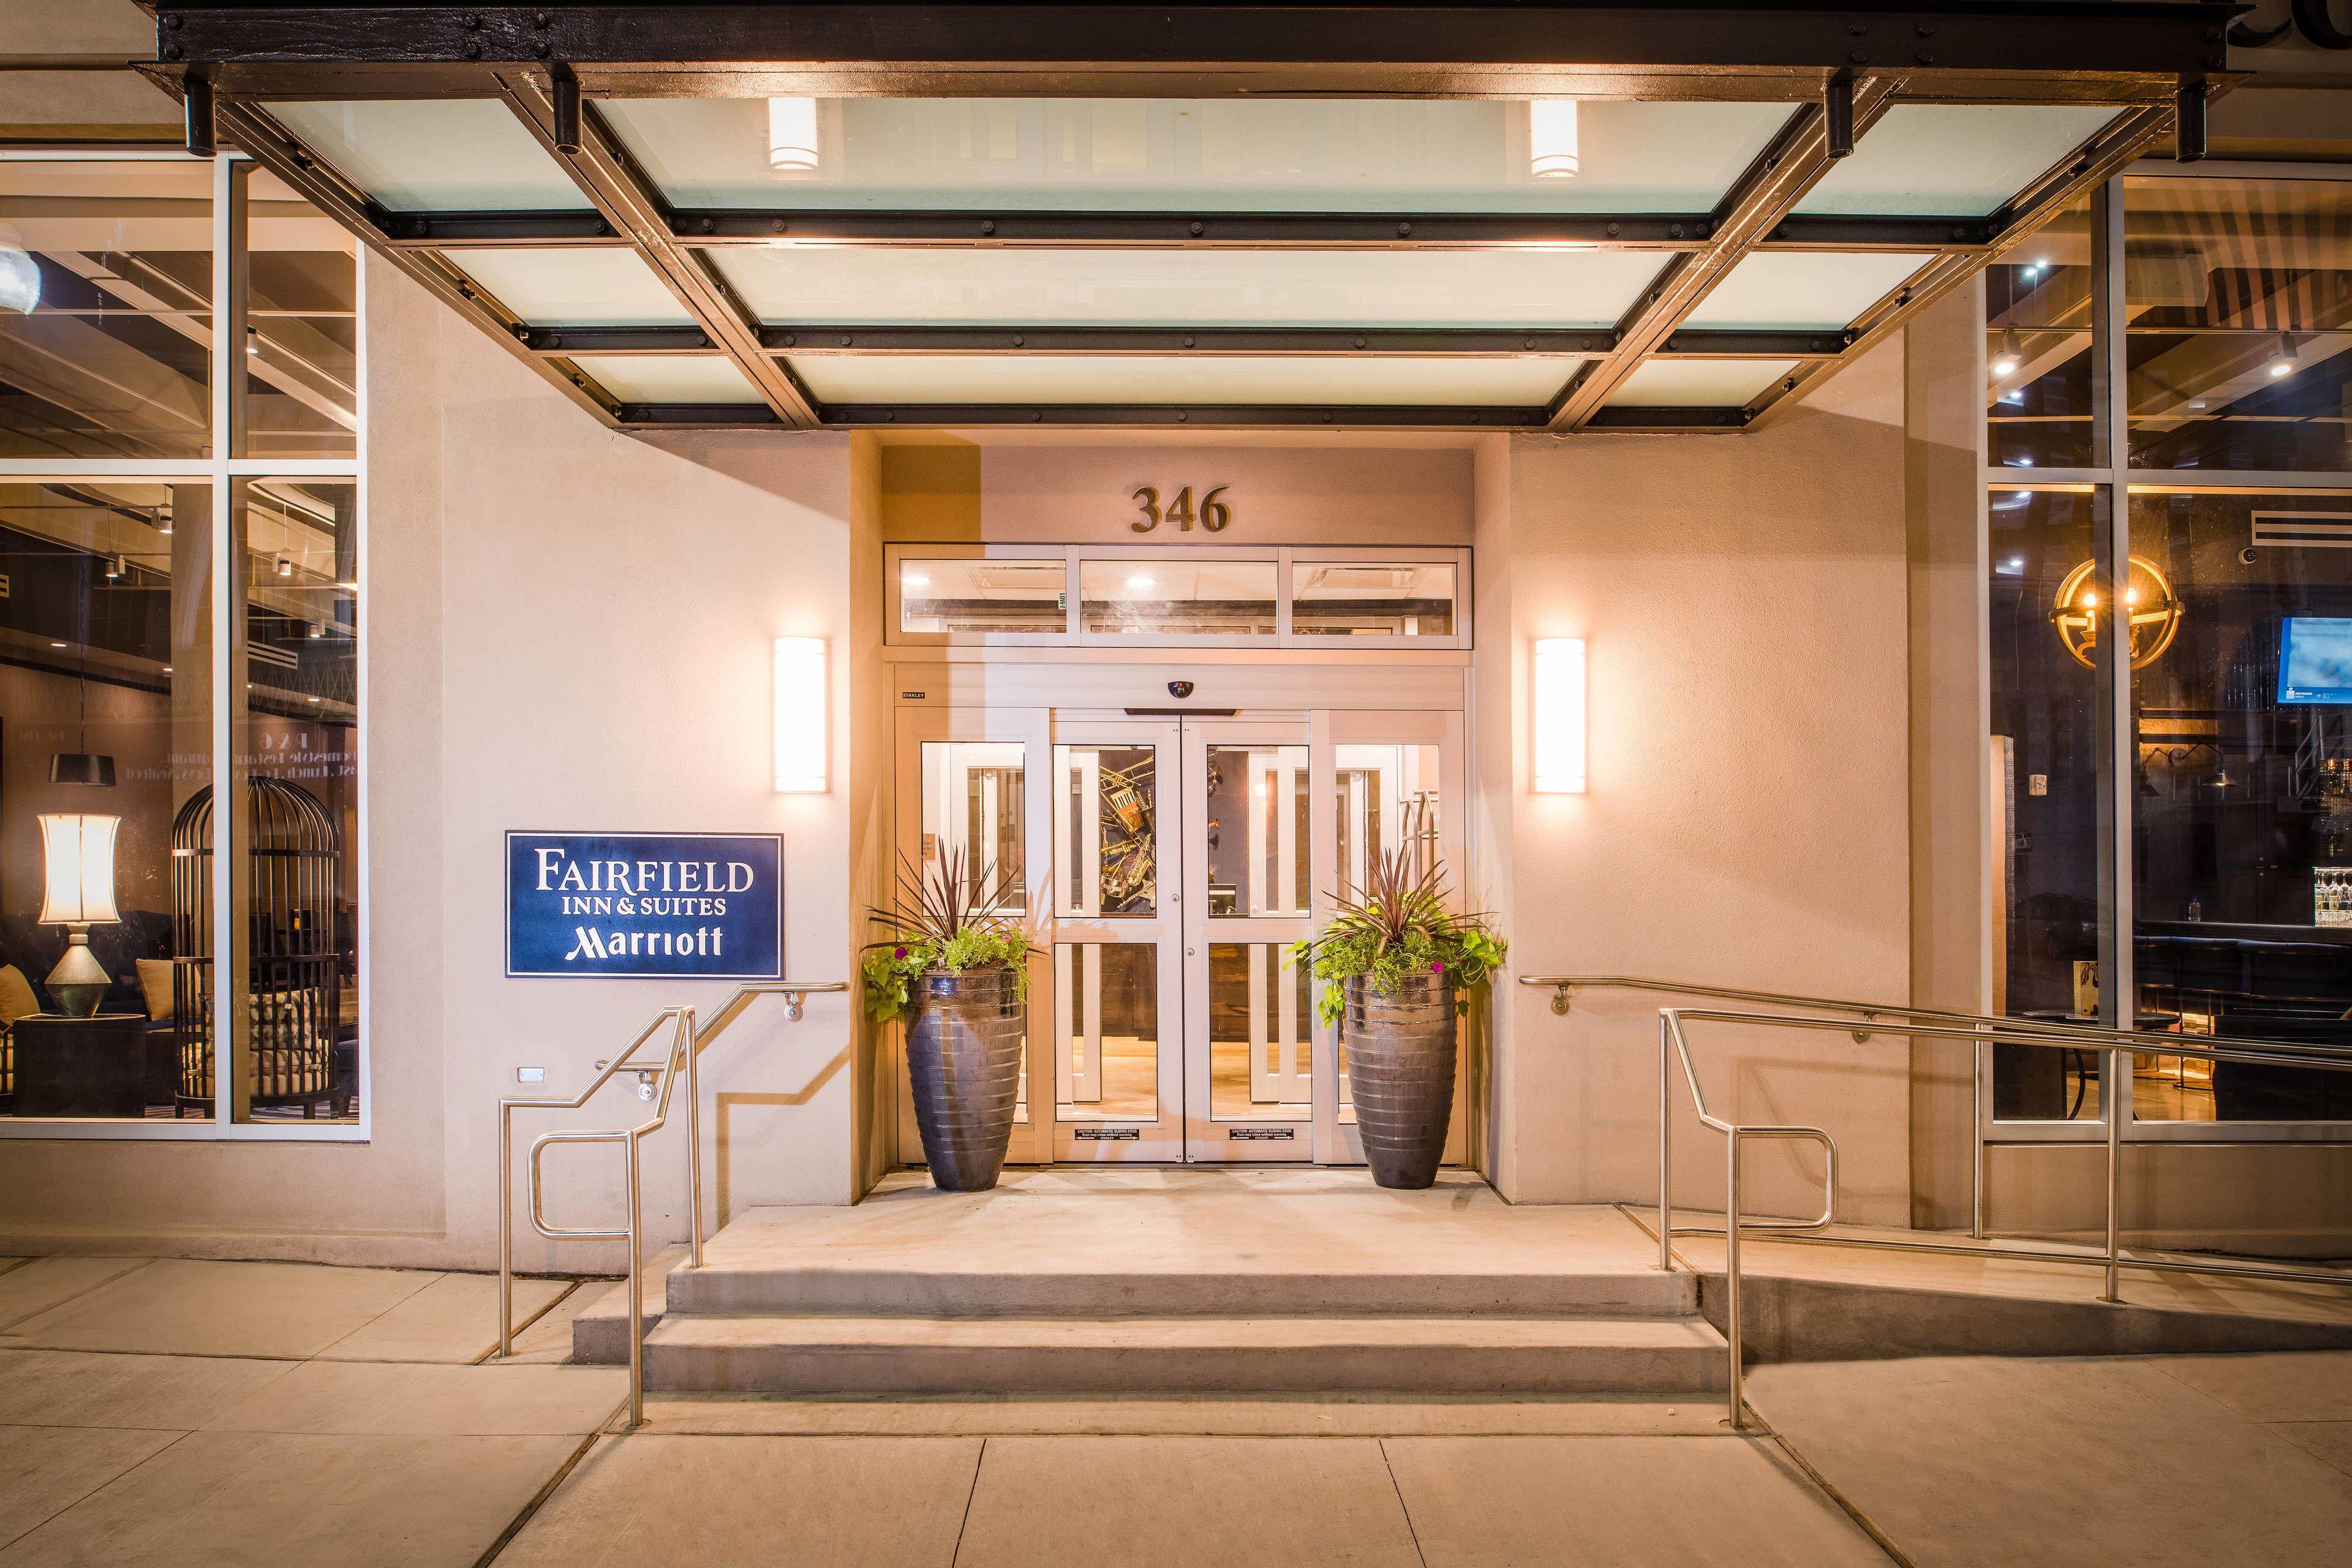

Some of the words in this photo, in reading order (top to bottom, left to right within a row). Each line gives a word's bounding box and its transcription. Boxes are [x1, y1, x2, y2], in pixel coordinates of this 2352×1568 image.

[1131, 486, 1231, 533] 346
[534, 848, 755, 896] FAIRFIELD
[562, 897, 613, 915] INN
[616, 897, 636, 915] &
[641, 897, 727, 916] SUITES
[564, 925, 723, 960] Marriott
